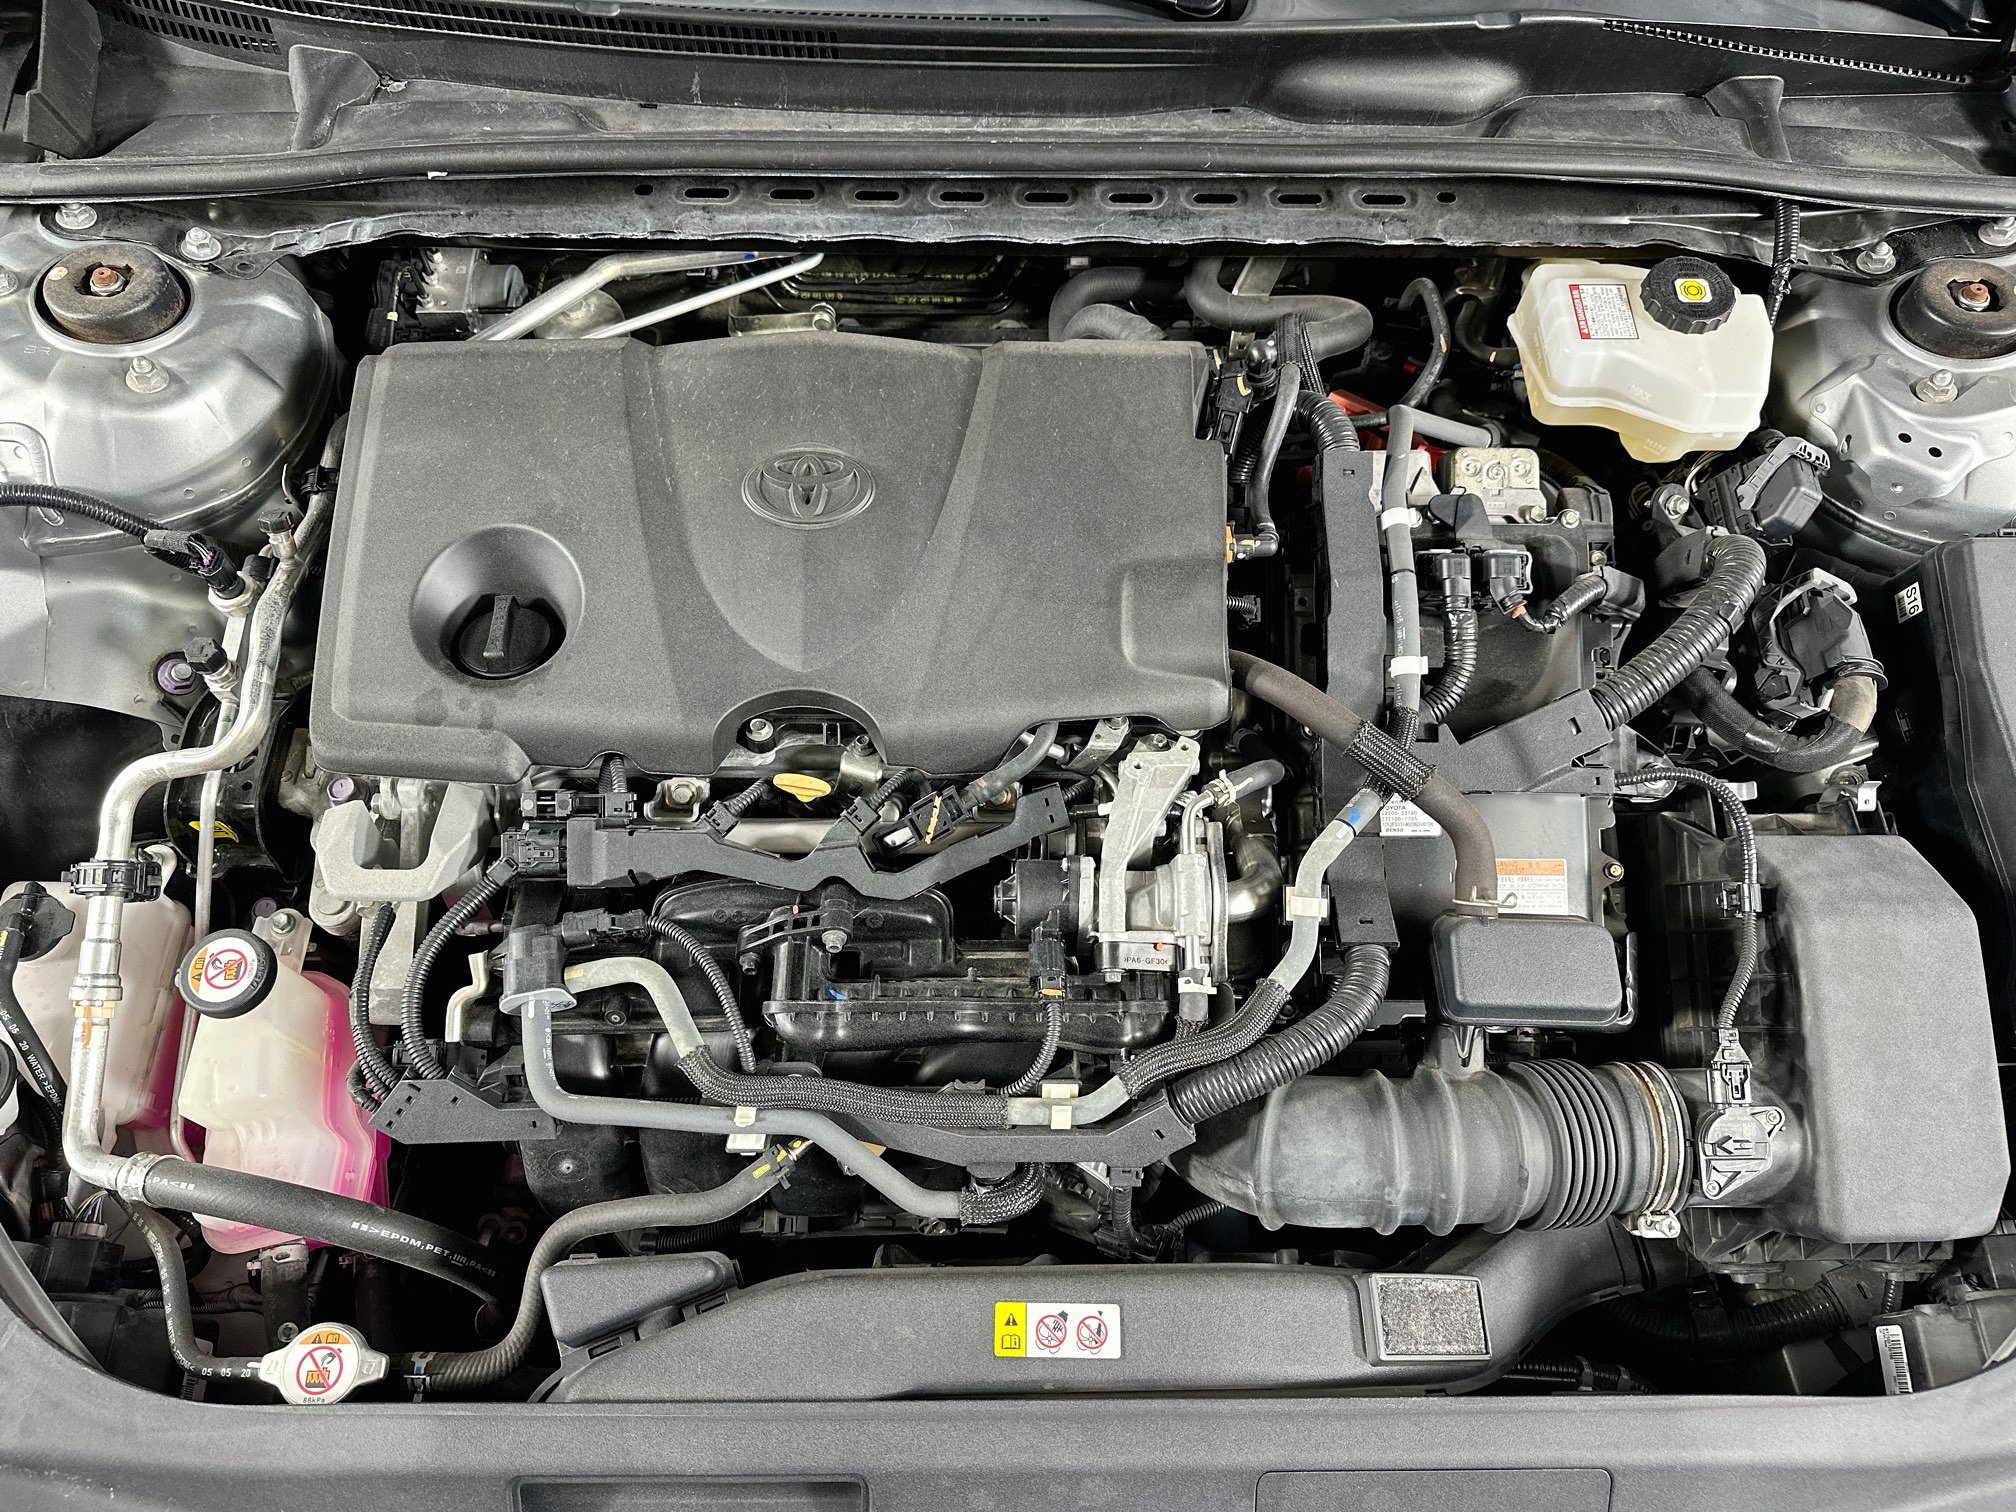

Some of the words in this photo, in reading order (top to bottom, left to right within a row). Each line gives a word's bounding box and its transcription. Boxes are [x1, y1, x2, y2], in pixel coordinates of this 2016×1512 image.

[1630, 384, 1652, 403] MAX
[1906, 586, 1920, 616] S16
[19, 1040, 30, 1052] 20
[27, 1053, 47, 1081] WATER
[165, 1303, 172, 1314] 20
[167, 1317, 176, 1346] WATER
[201, 1367, 213, 1377] 05
[220, 1367, 232, 1377] 05
[240, 1368, 251, 1378] 20
